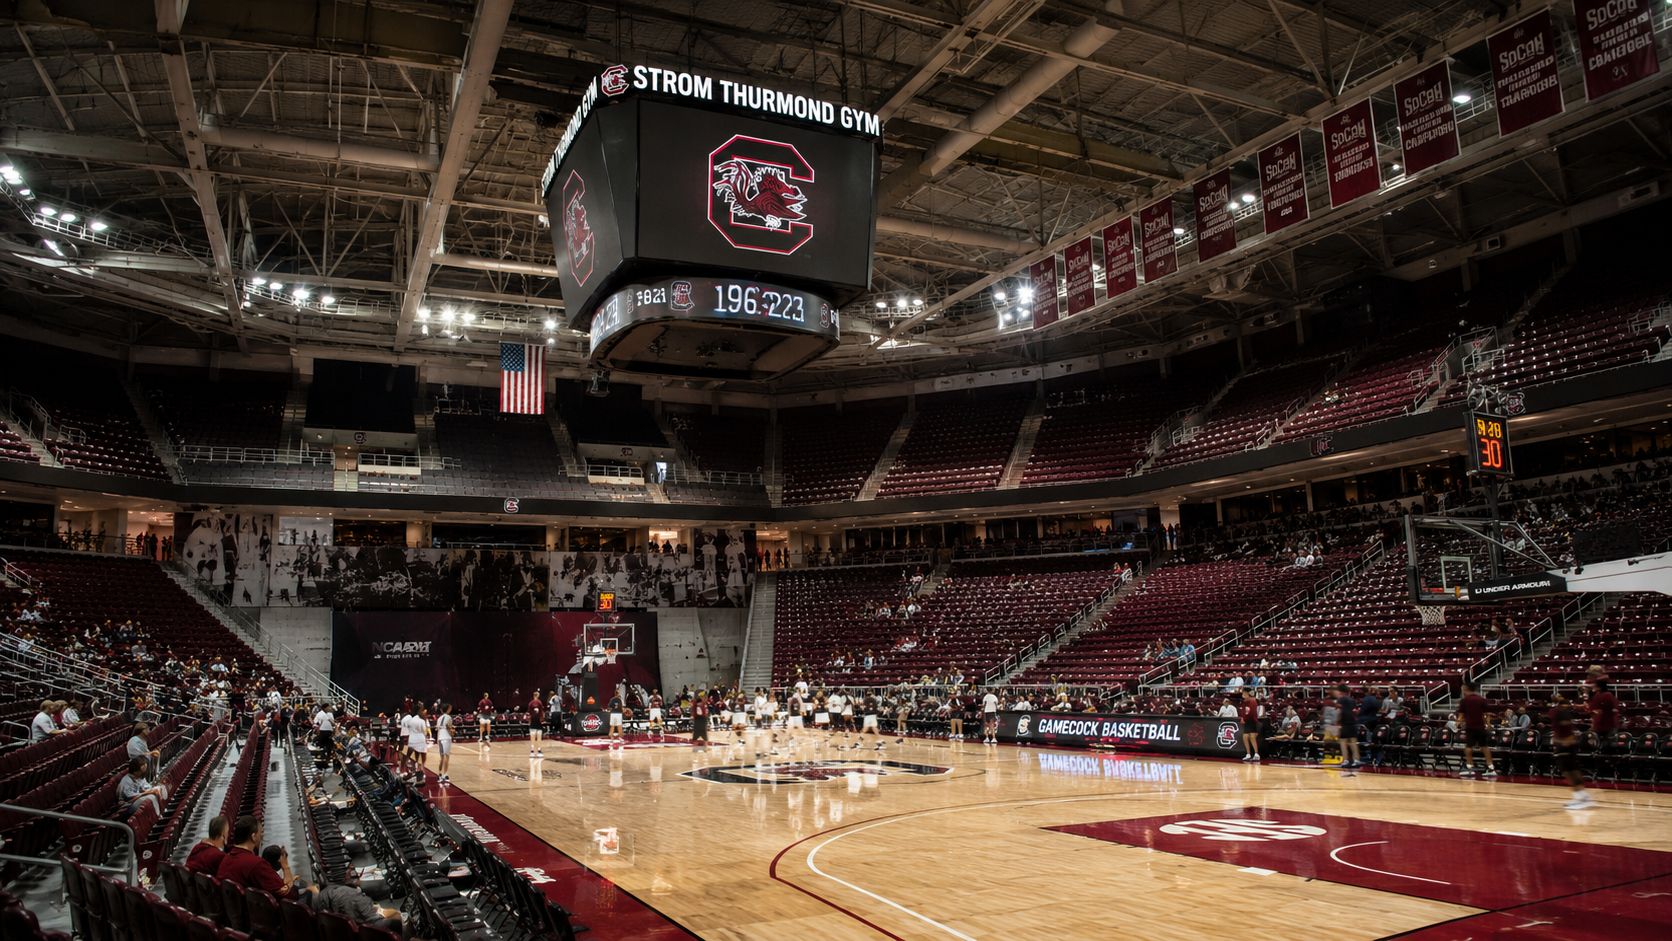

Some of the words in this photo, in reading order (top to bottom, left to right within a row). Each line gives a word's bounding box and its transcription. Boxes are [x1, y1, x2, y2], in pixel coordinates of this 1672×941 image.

[633, 65, 712, 100] STROM
[719, 80, 835, 125] THURMOND
[840, 106, 880, 136] GYM
[1481, 438, 1502, 468] 30
[1483, 585, 1511, 594] UNDER
[1038, 718, 1099, 736] GAMECOCK
[1101, 721, 1181, 741] BASKETBALL
